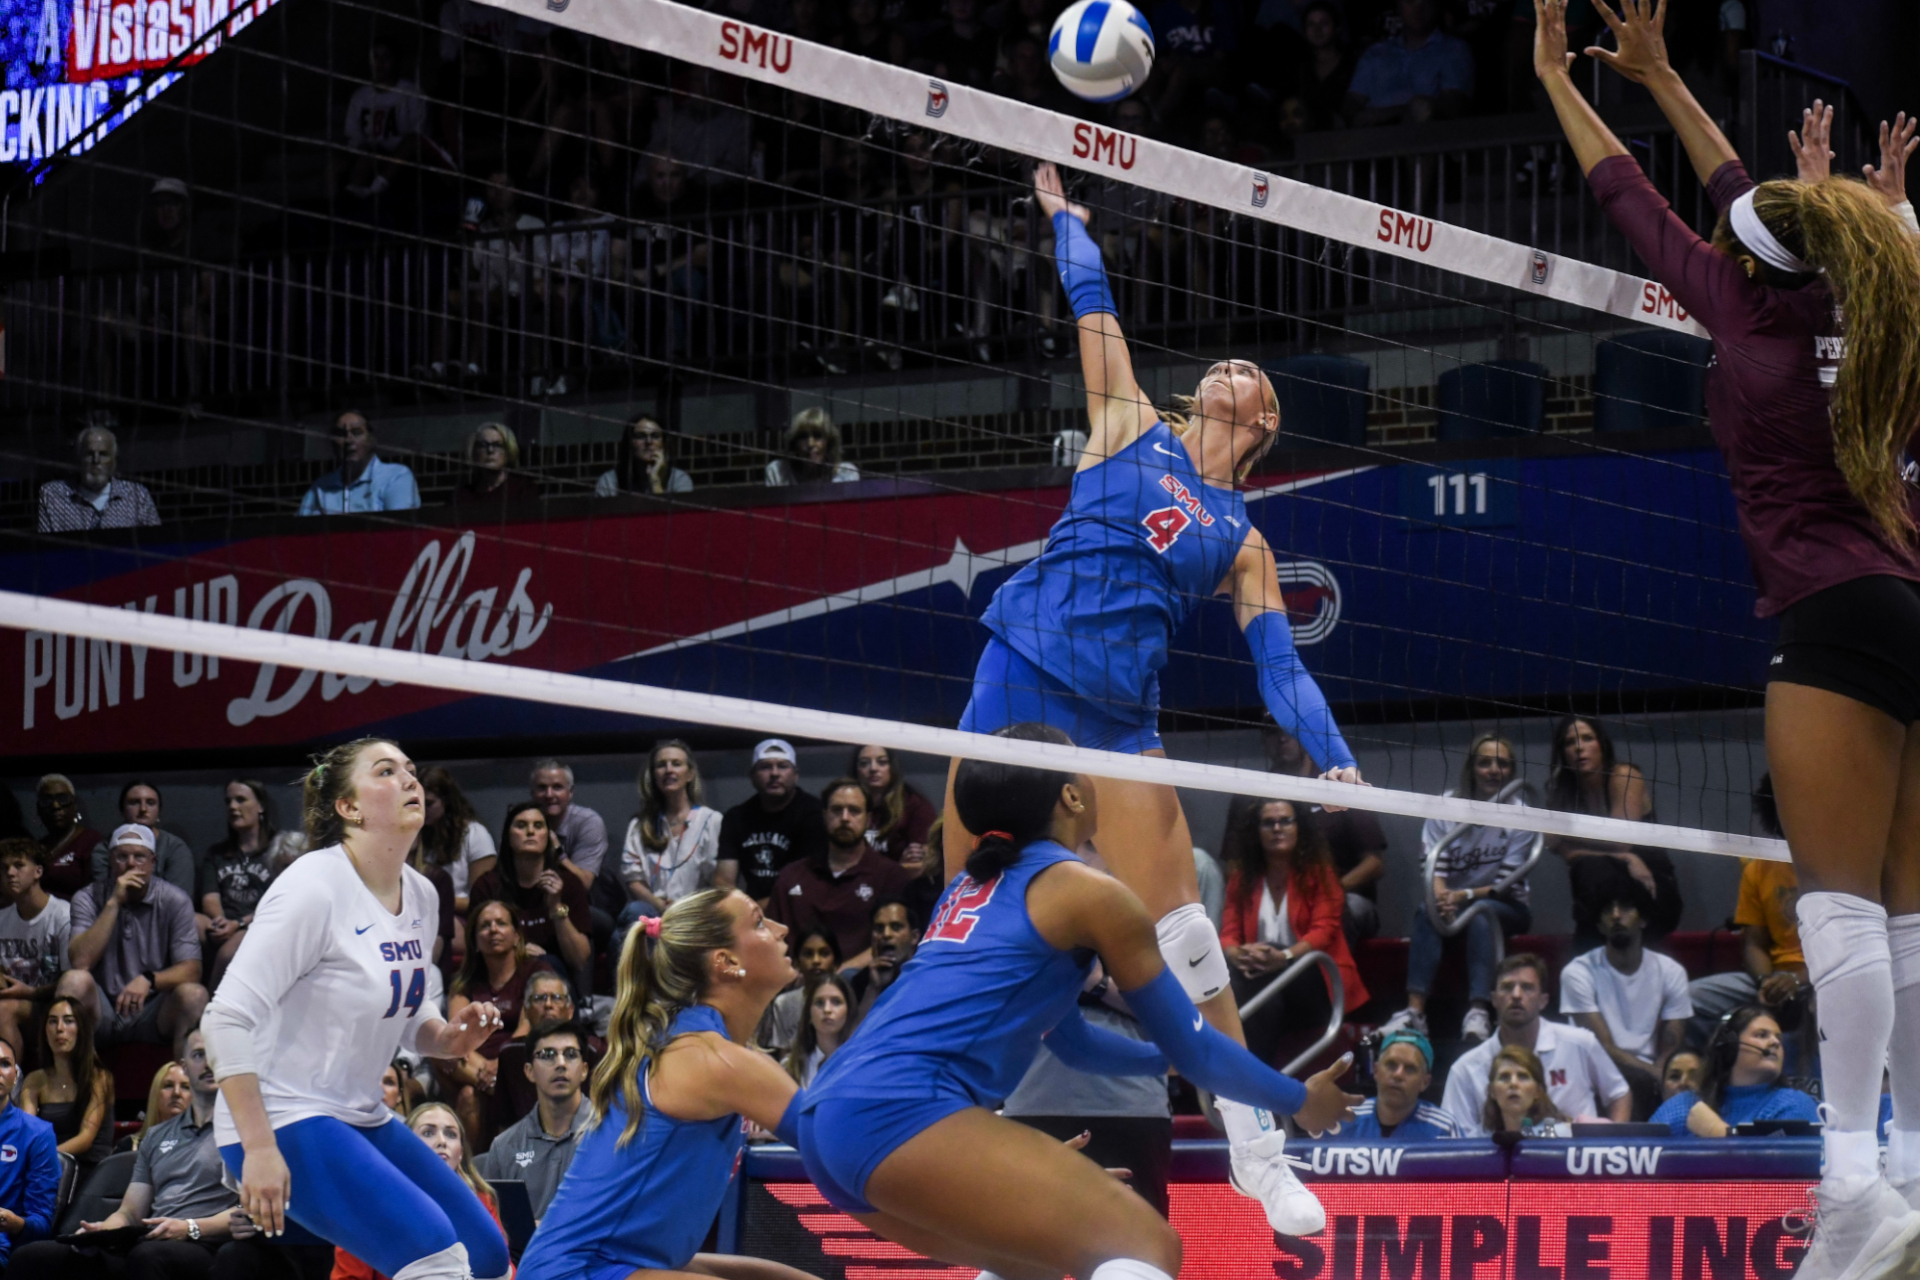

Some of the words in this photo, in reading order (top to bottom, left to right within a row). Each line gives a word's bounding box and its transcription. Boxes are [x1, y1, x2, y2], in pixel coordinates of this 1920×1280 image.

[36, 0, 61, 65] A
[719, 21, 793, 74] SMU
[1073, 123, 1136, 171] SMU
[1377, 208, 1433, 252] SMU
[1158, 473, 1216, 527] SMU
[1427, 472, 1487, 516] 111
[1141, 505, 1192, 555] 4
[23, 594, 157, 730] PONY
[172, 573, 239, 688] UP
[226, 531, 554, 726] Dallas
[918, 874, 1005, 944] 12
[379, 939, 423, 962] SMU
[381, 967, 426, 1019] 14
[1549, 1068, 1567, 1086] N
[515, 1150, 535, 1160] SMU
[1311, 1146, 1404, 1176] UTSW
[1566, 1145, 1663, 1176] UTSW
[1272, 1215, 1614, 1280] SIMPLE
[1648, 1215, 1813, 1280] ING
